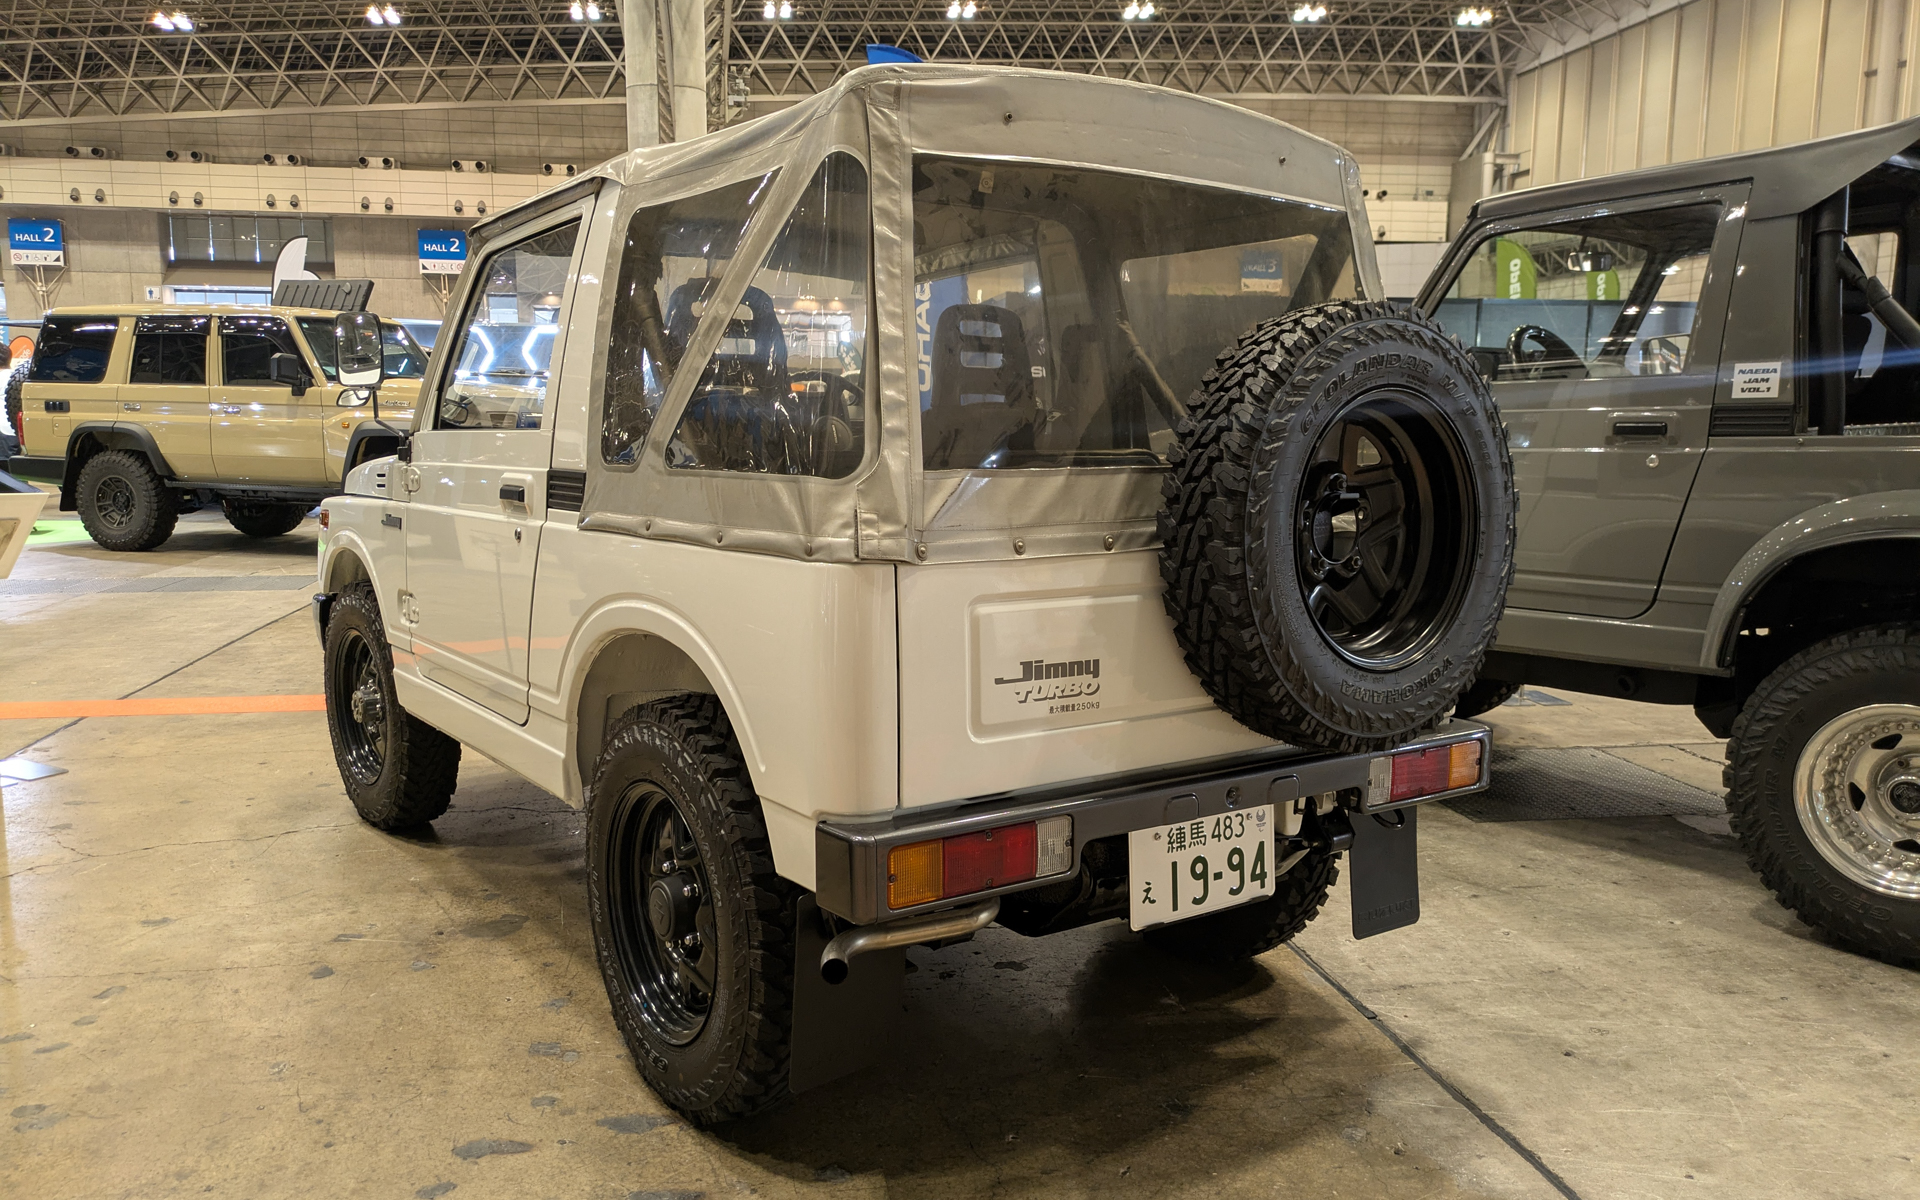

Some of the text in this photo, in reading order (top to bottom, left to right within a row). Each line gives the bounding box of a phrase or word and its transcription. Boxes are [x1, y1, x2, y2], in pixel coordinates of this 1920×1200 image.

[15, 227, 56, 242] HALL 2
[423, 238, 461, 252] HALL 2
[1301, 352, 1478, 437] GEOLANDAR M/T
[994, 659, 1100, 685] Jimny
[1340, 654, 1454, 706] YOKOHAMA
[1015, 681, 1100, 704] TURBO
[1166, 812, 1246, 854] 練馬 483
[1142, 840, 1268, 912] え 19-94
